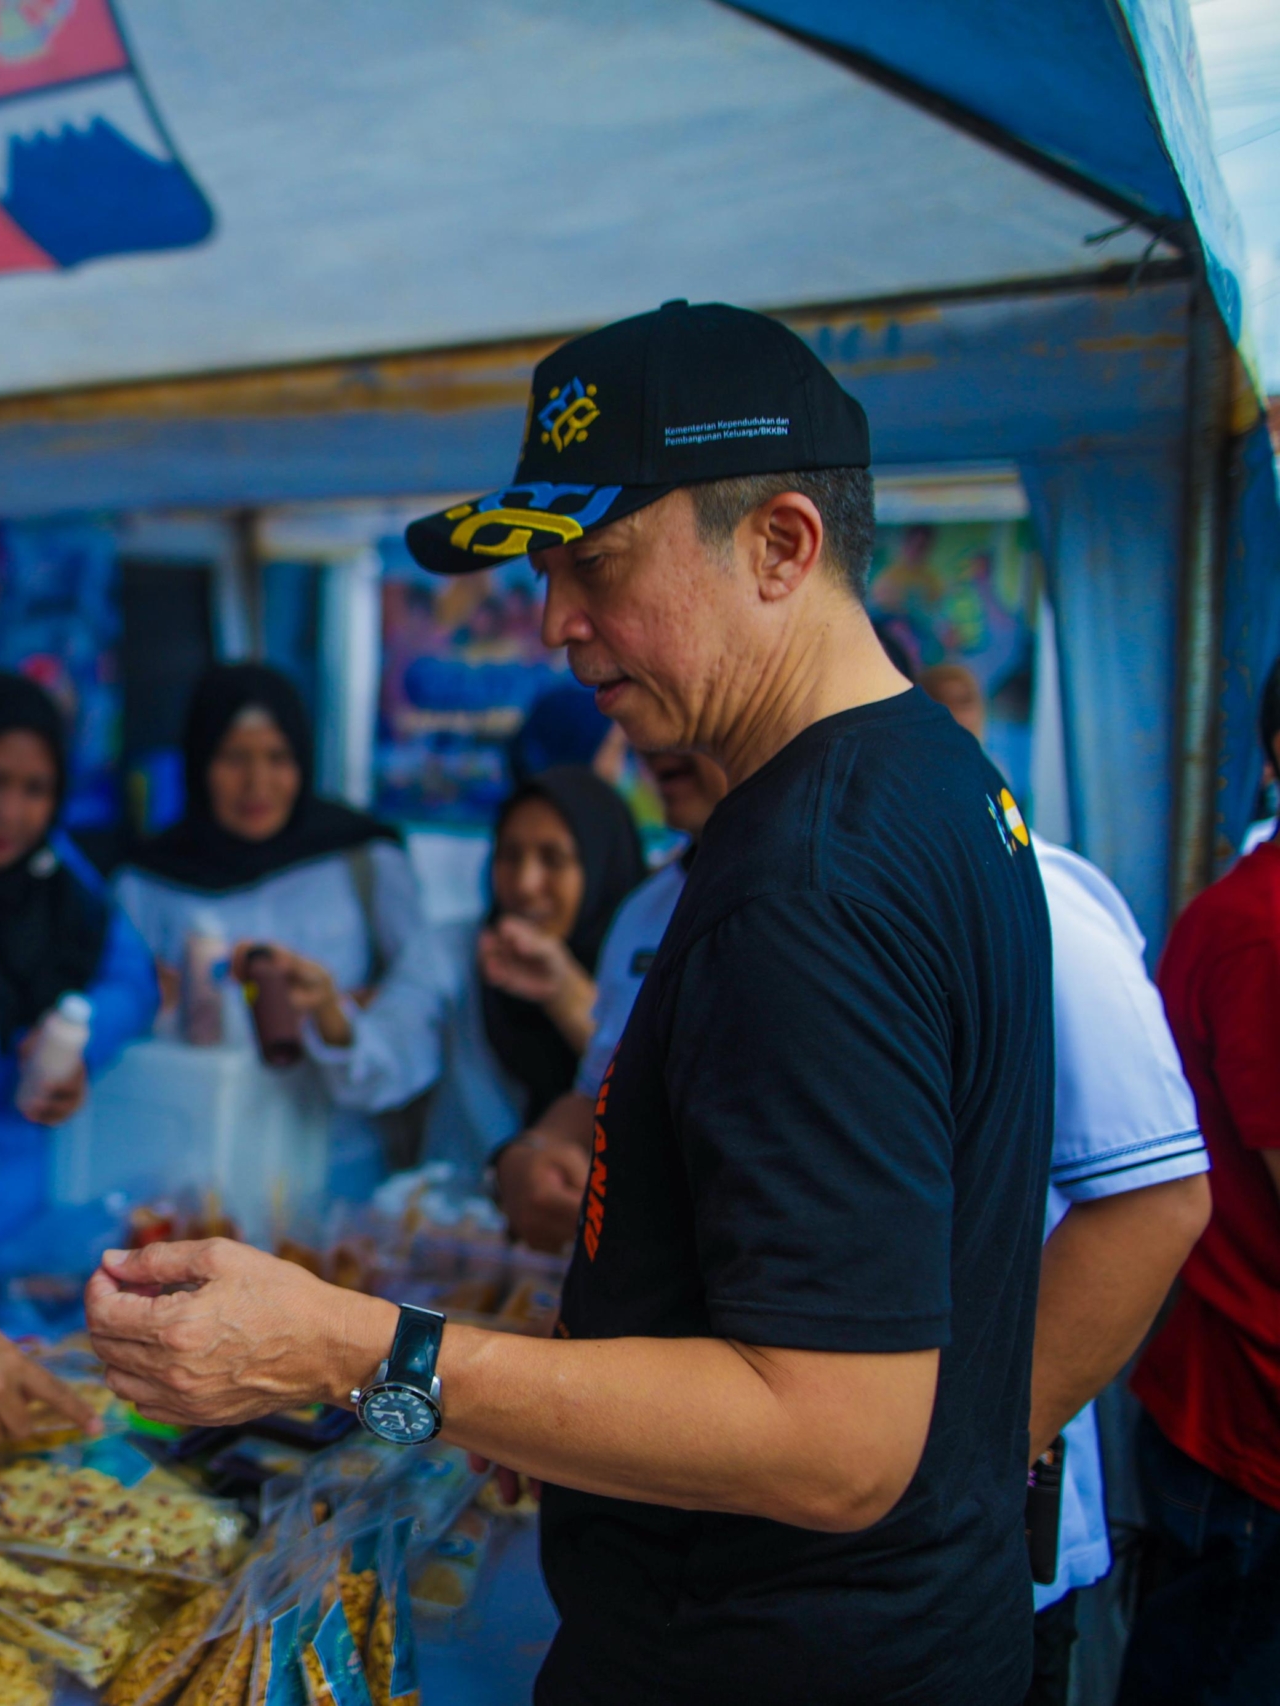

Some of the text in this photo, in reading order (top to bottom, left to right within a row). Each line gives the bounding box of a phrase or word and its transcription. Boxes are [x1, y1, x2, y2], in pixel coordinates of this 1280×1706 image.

[665, 416, 790, 436] Kementerian Kependudukan dan
[665, 426, 788, 447] Pembangunan Keluarga/BKKBN
